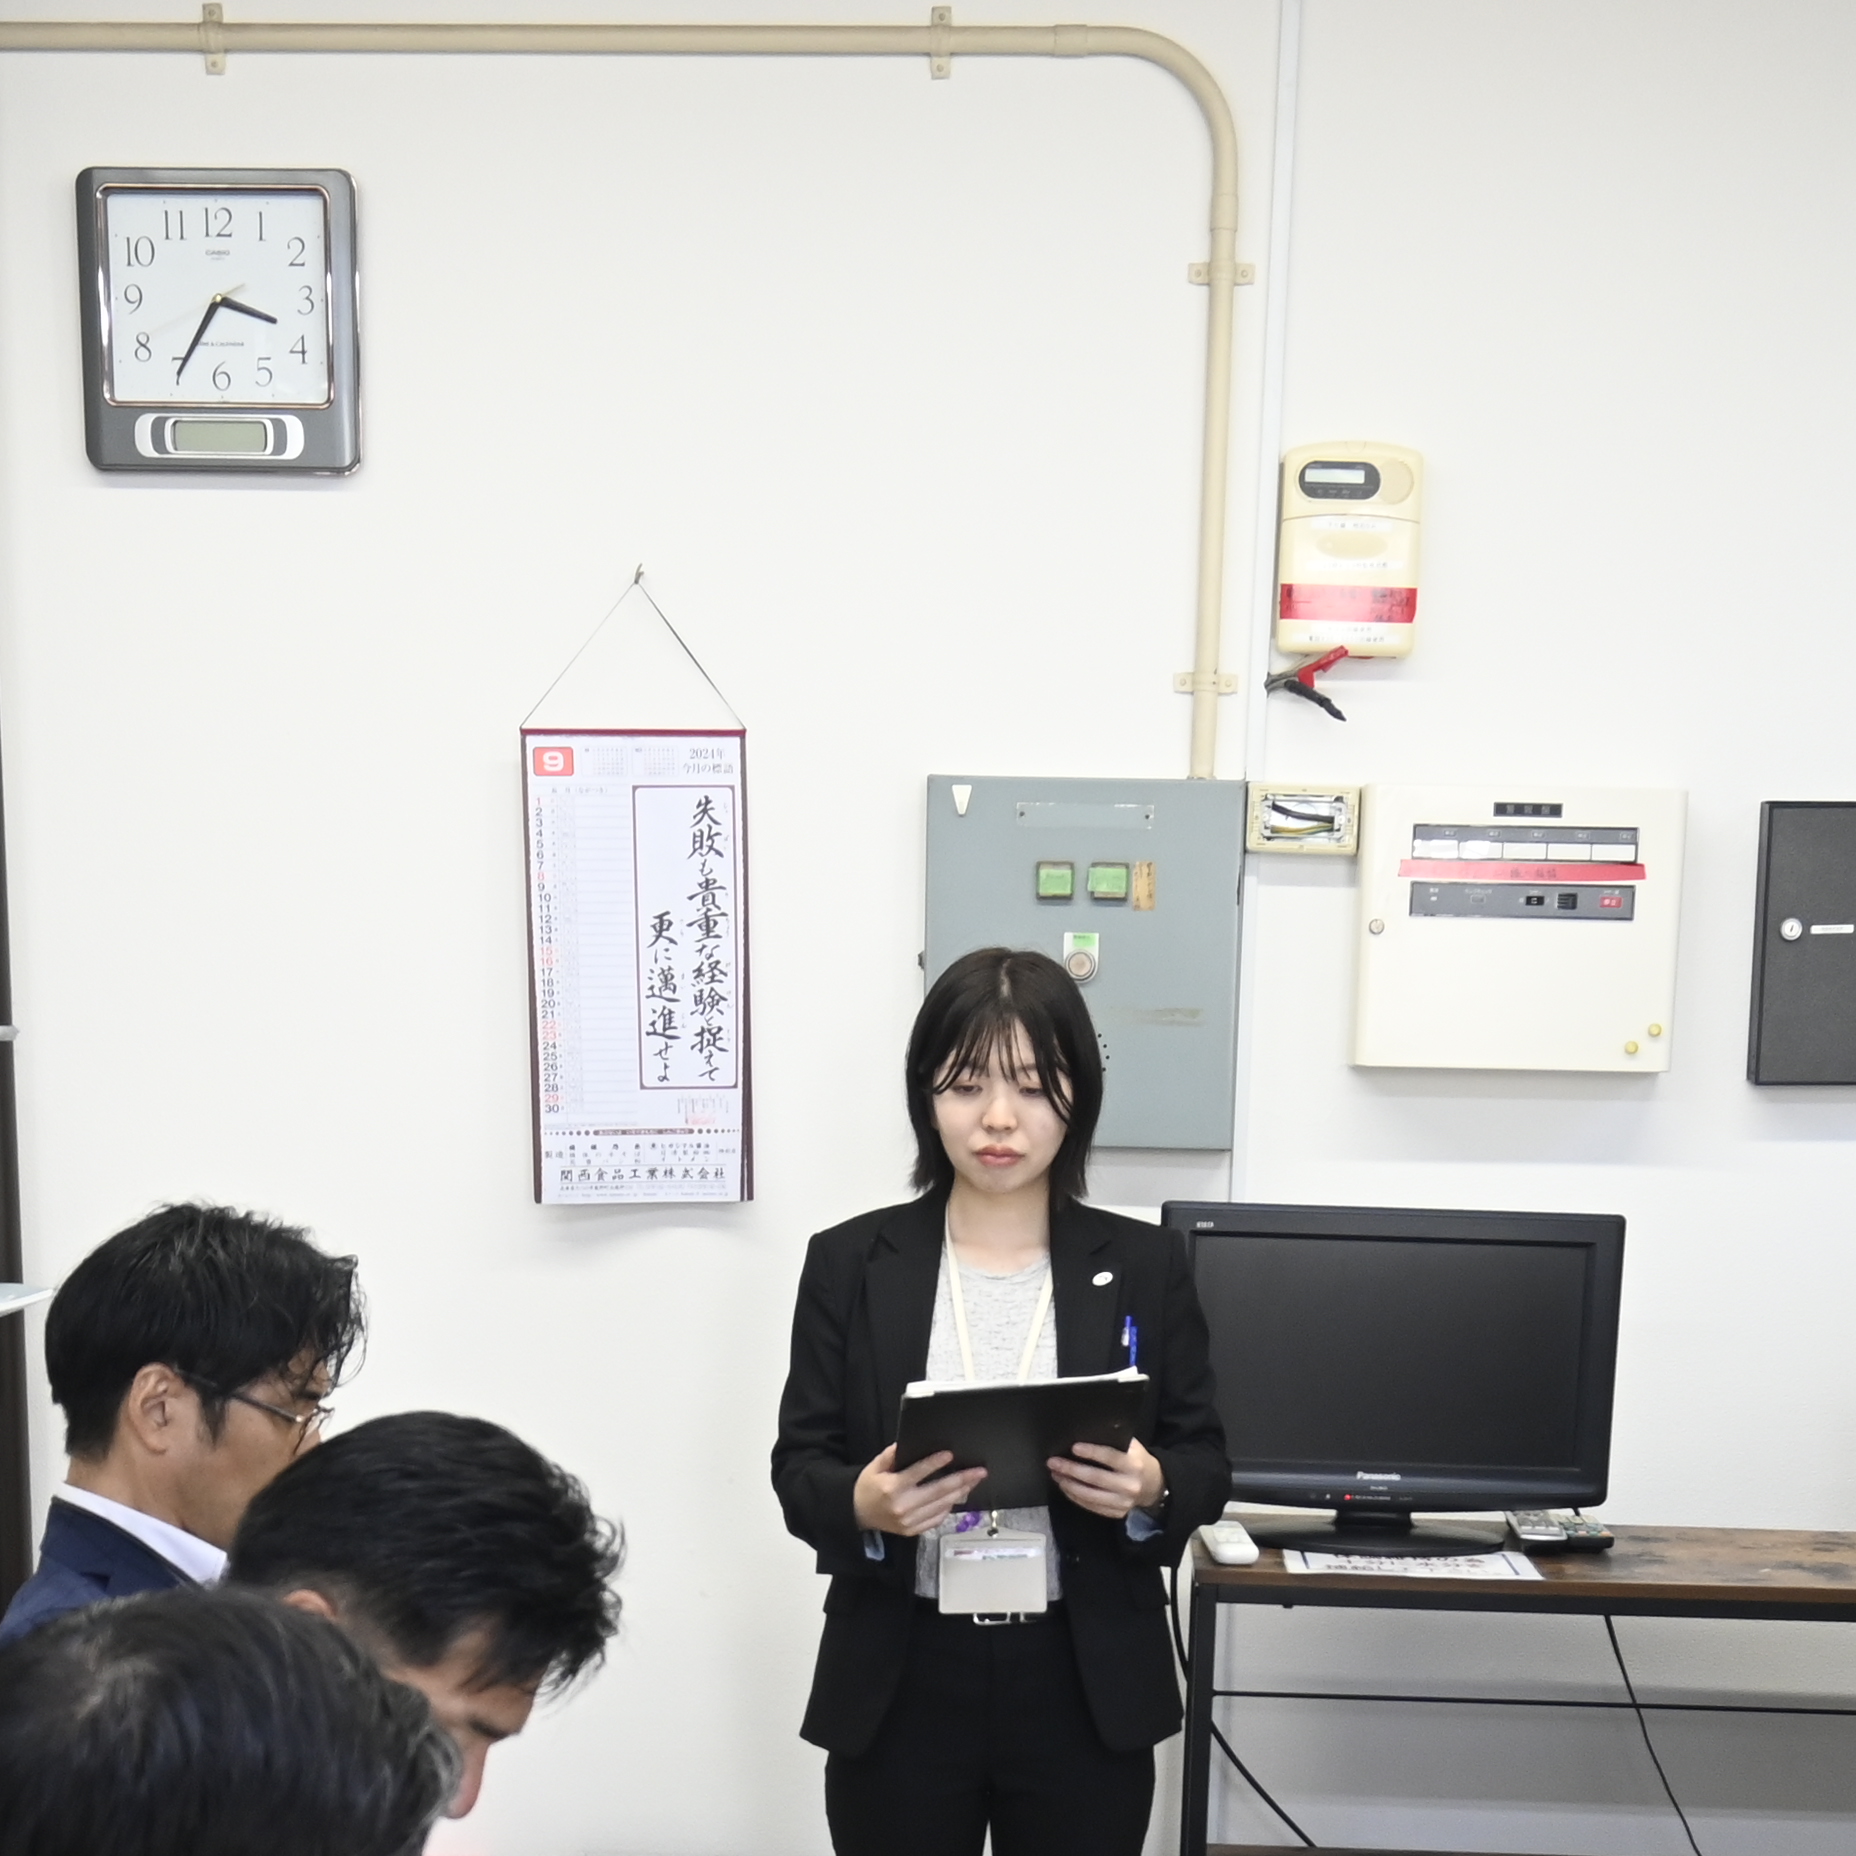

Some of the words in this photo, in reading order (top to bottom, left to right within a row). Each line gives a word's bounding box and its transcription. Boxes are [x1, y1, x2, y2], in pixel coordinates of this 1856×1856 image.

[163, 209, 187, 241] 11
[203, 206, 233, 238] 12
[257, 210, 267, 242] 1
[125, 235, 156, 268] 10
[286, 236, 306, 268] 2
[123, 283, 144, 315] 9
[297, 284, 316, 316] 3
[133, 331, 153, 363] 8
[288, 334, 308, 365] 4
[211, 360, 232, 391] 6
[255, 356, 273, 388] 5
[542, 751, 565, 772] 9
[682, 762, 734, 775] 今月の標語
[689, 747, 725, 760] 2024年
[686, 794, 729, 1082] 失敗も貴重な経験と捉えて
[645, 910, 682, 1083] 更に邁進せよ
[560, 1166, 726, 1182] 関西食品工業株式会社
